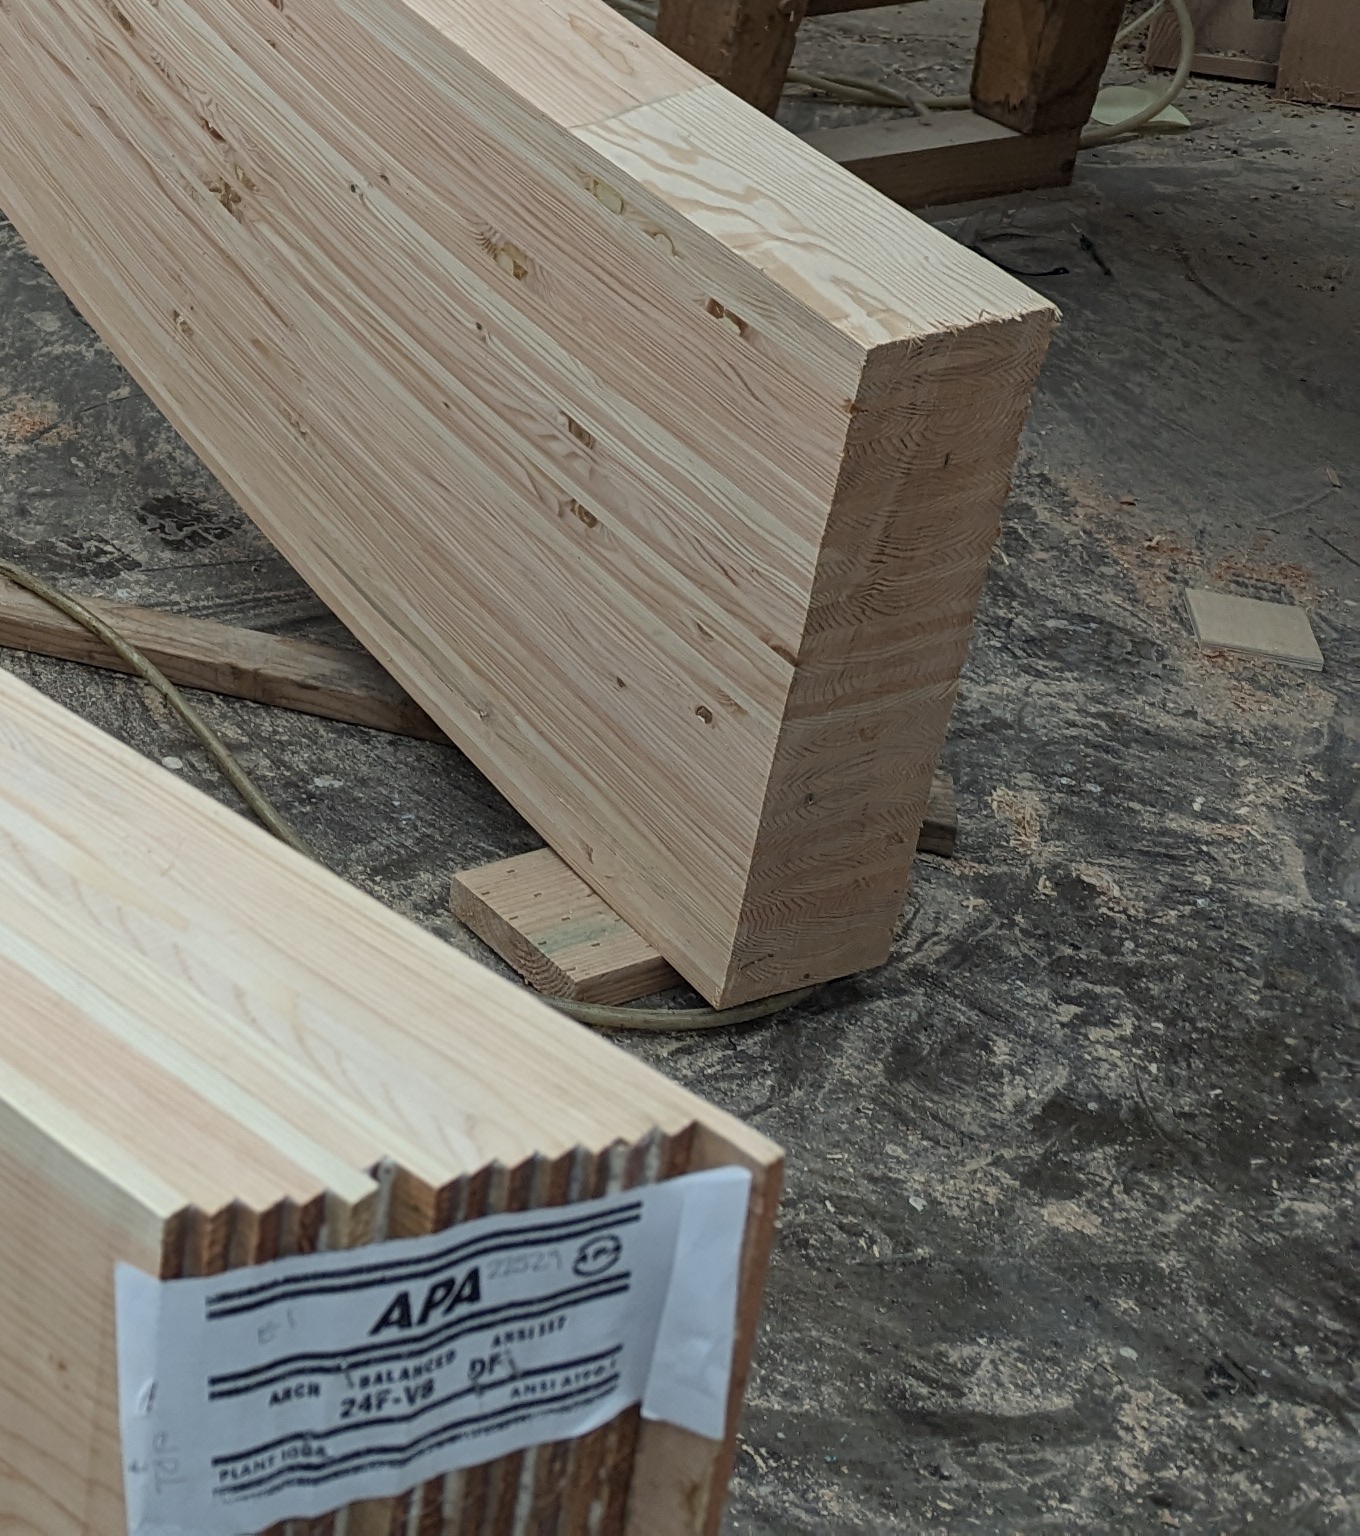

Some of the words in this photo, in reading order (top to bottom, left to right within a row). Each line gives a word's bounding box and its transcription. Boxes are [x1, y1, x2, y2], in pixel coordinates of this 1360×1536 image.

[367, 1266, 480, 1337] APA
[357, 1349, 457, 1390] BALANCED
[268, 1381, 322, 1407] ARCH
[339, 1376, 436, 1419] 24F-V8
[218, 1456, 276, 1482] PLANT
